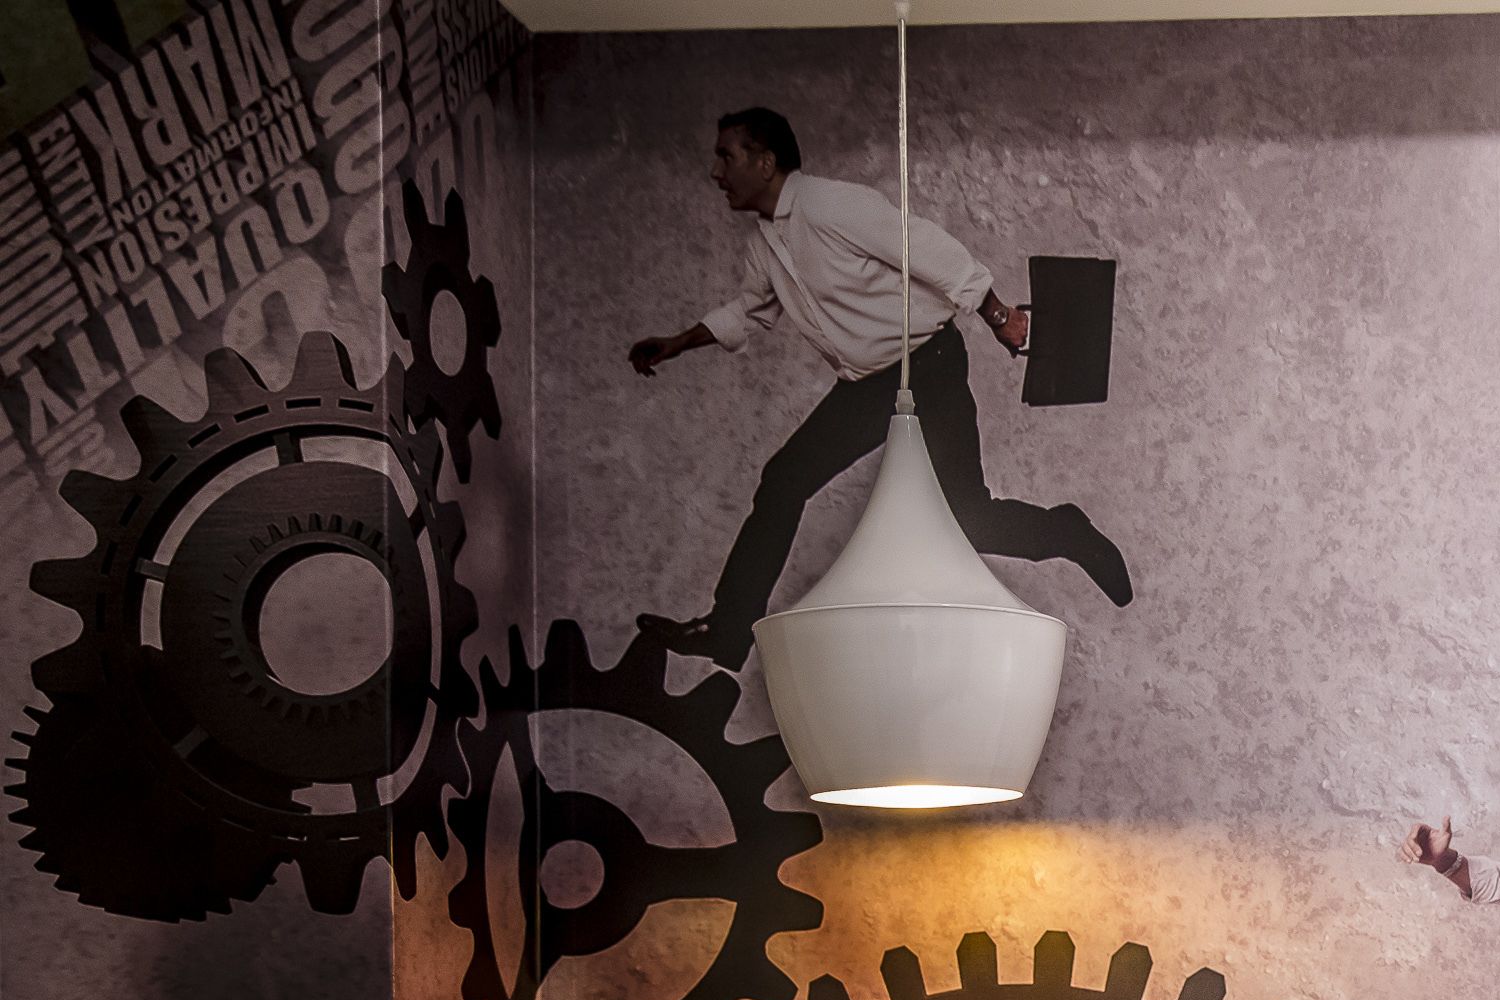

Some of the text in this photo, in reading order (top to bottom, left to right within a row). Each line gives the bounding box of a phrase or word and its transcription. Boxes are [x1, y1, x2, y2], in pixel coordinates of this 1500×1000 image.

[28, 114, 114, 254] ENTITY
[80, 103, 318, 309] IMPRESION
[112, 80, 301, 227] INFORMATION
[19, 161, 330, 441] QUALITY
